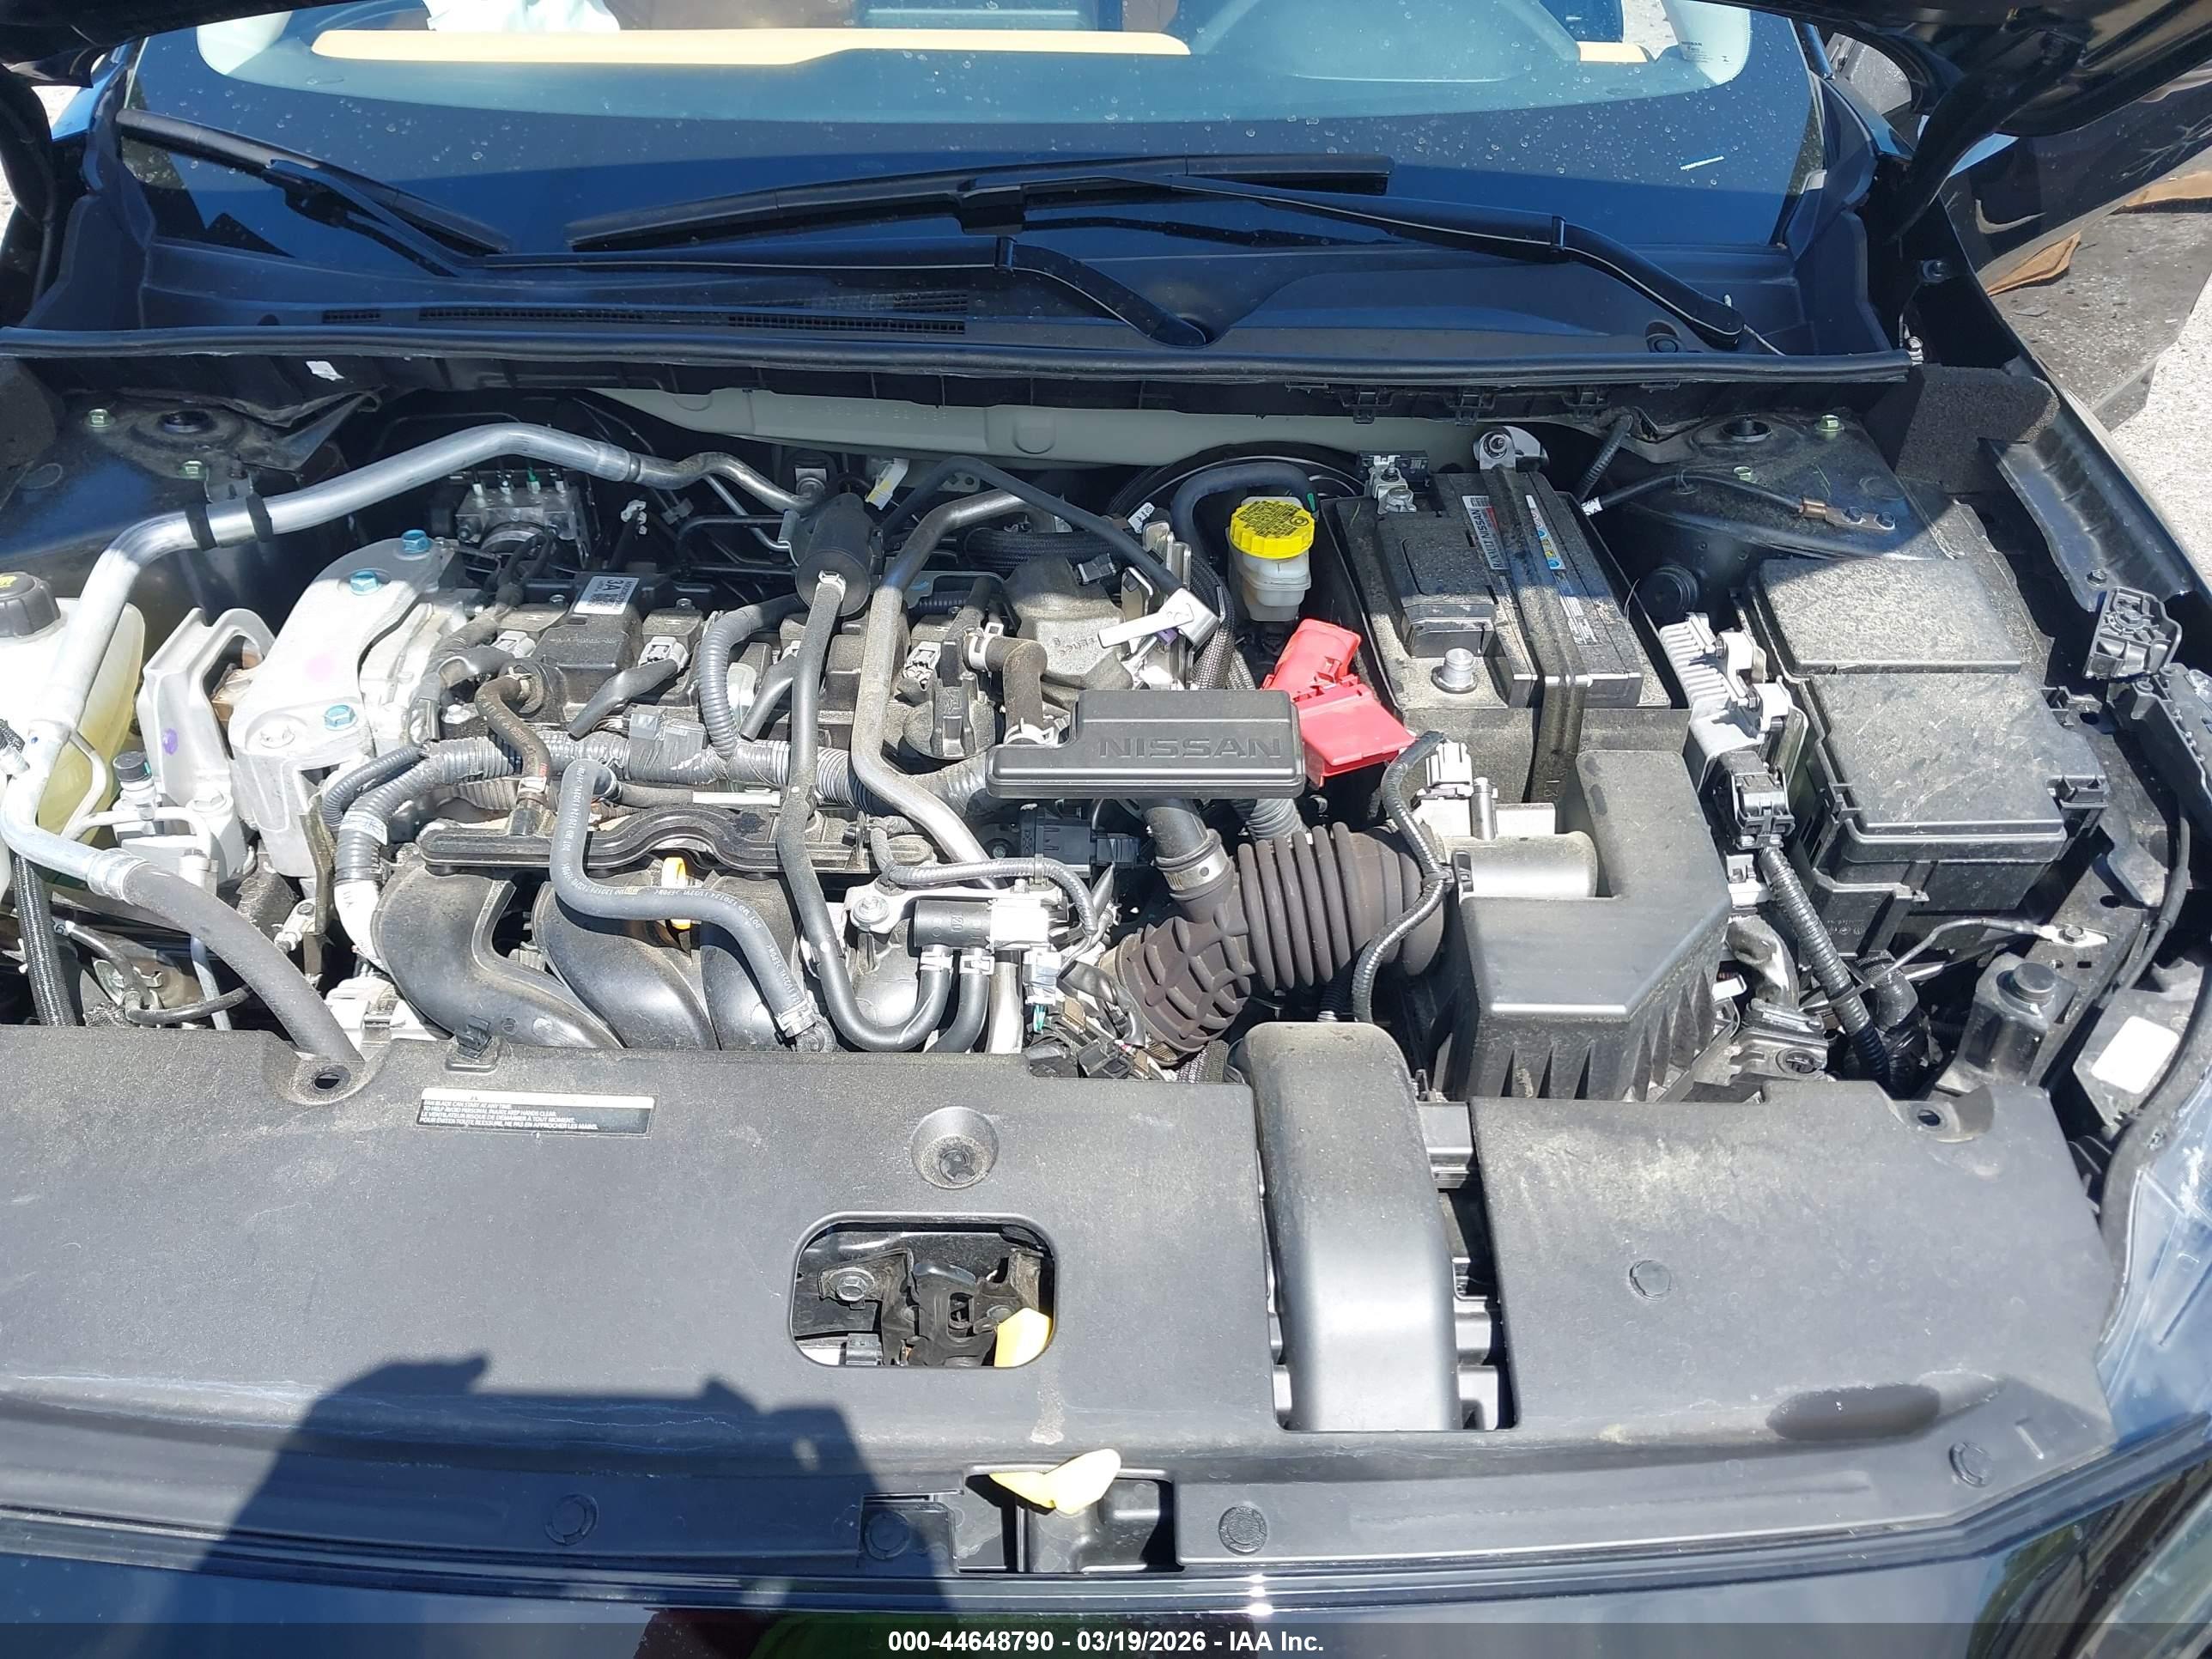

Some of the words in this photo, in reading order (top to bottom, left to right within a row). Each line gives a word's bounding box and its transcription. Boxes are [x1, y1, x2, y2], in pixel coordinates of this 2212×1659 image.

[1471, 509, 1490, 538] NISSAN
[603, 579, 623, 591] 3A
[1099, 737, 1282, 758] NISSAN
